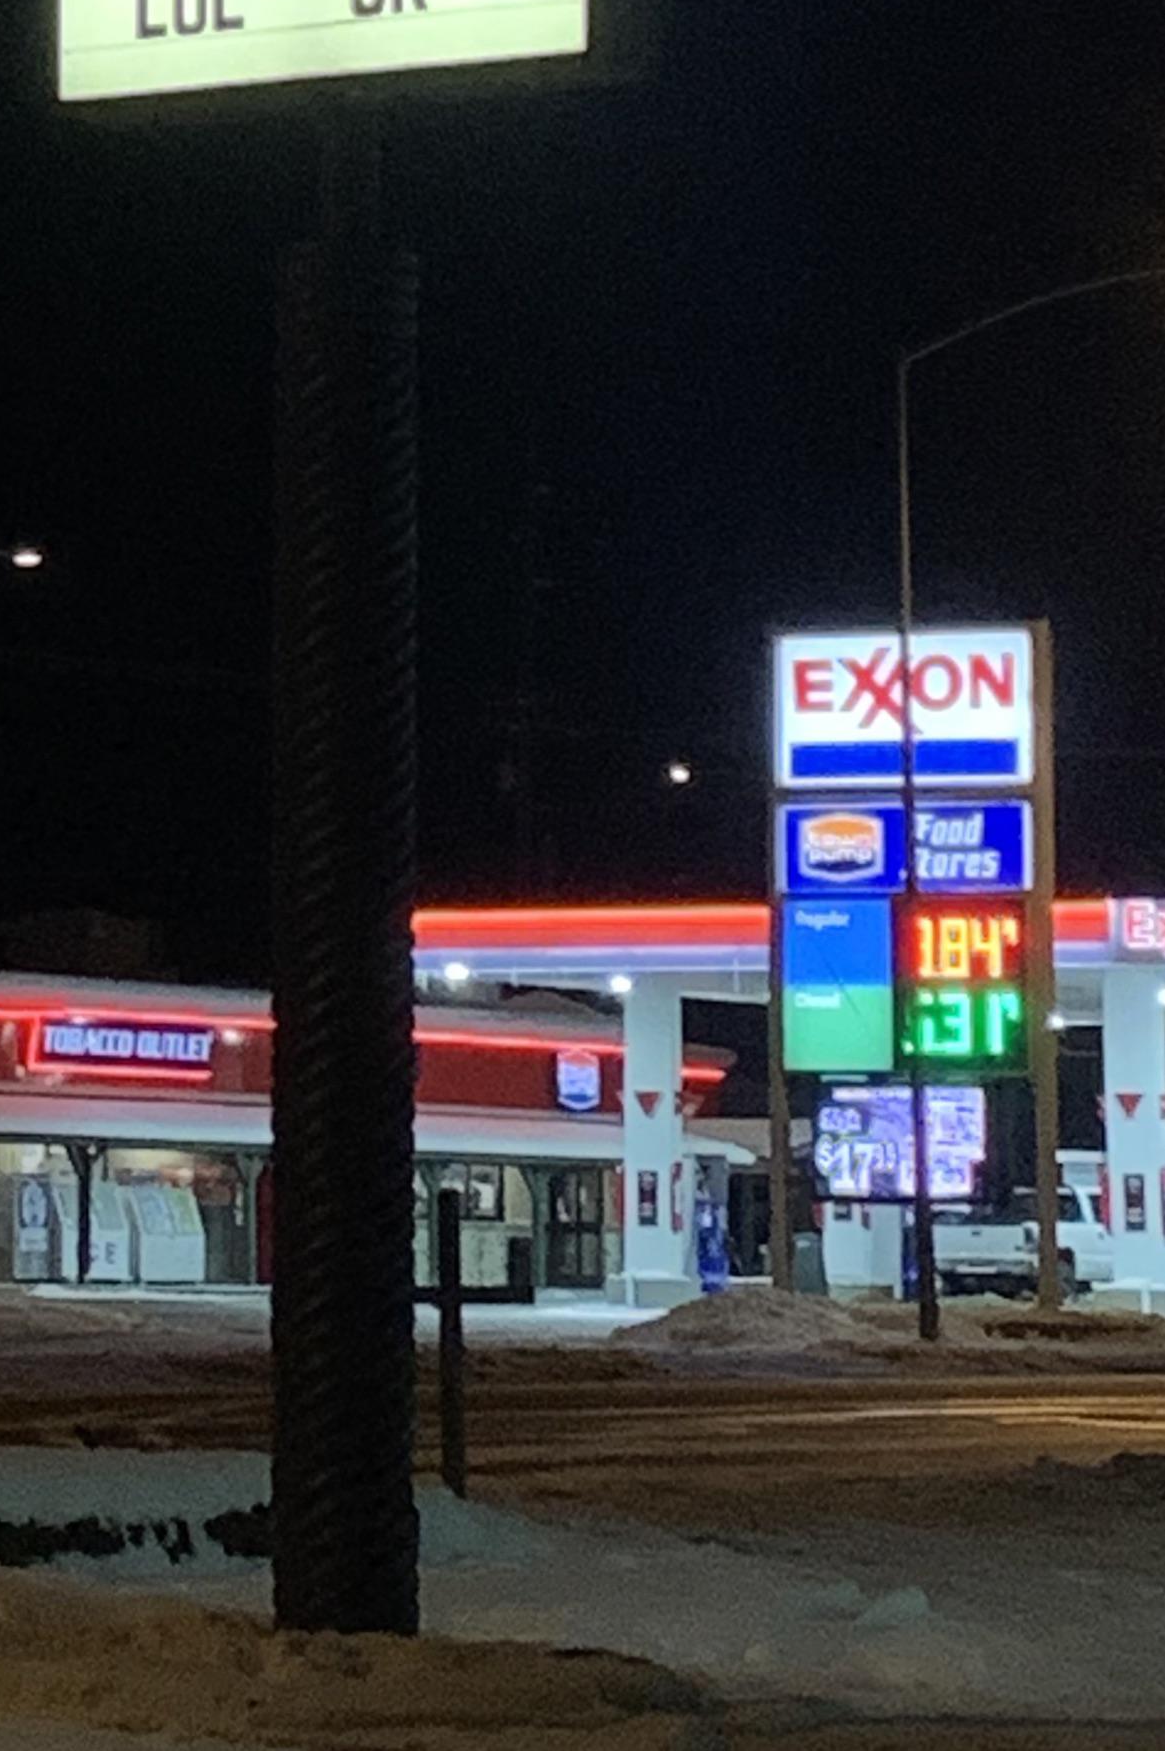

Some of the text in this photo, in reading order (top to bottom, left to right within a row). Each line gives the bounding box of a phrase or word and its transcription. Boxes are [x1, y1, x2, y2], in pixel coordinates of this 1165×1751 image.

[792, 647, 1015, 735] EXXON
[915, 811, 984, 846] Food
[899, 848, 1001, 879] tores
[43, 1024, 215, 1062] TOBACCO OUTLET
